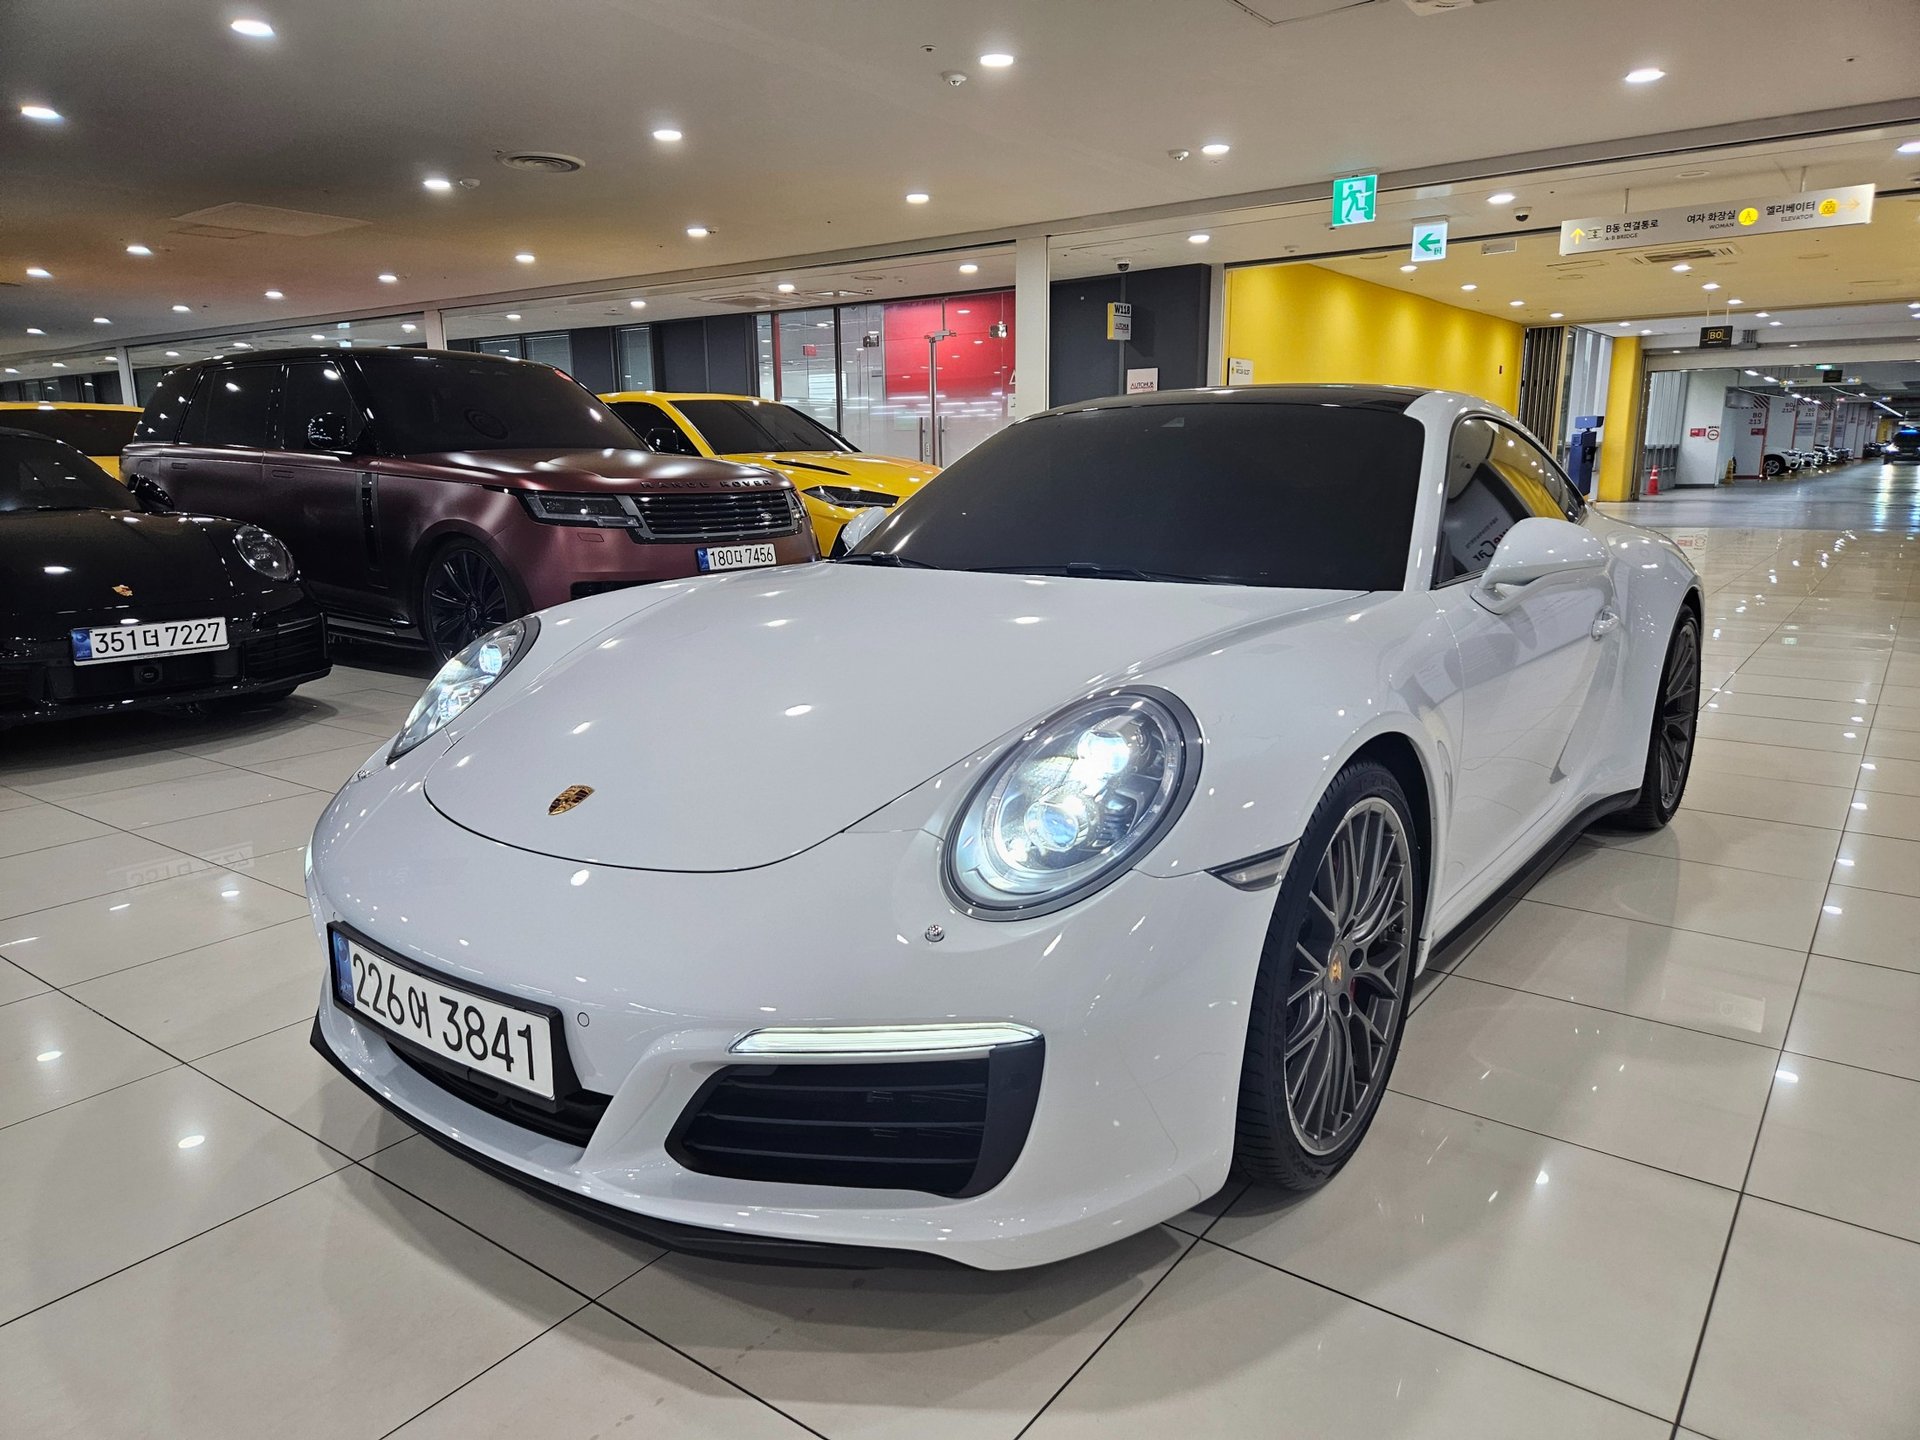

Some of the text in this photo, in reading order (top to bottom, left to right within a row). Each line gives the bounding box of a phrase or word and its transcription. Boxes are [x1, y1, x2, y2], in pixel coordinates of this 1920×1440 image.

[1765, 200, 1816, 216] 엘리베이터
[1686, 209, 1736, 224] 여자 화장실
[1780, 213, 1814, 222] ELEVATOR
[1605, 218, 1659, 233] B동 연결통로
[1709, 222, 1734, 230] WOMAN
[1114, 303, 1131, 315] W118
[719, 480, 772, 488] ROVER
[744, 546, 774, 564] 7456
[94, 622, 221, 654] 351더 7227
[352, 952, 536, 1081] 226어 3841
